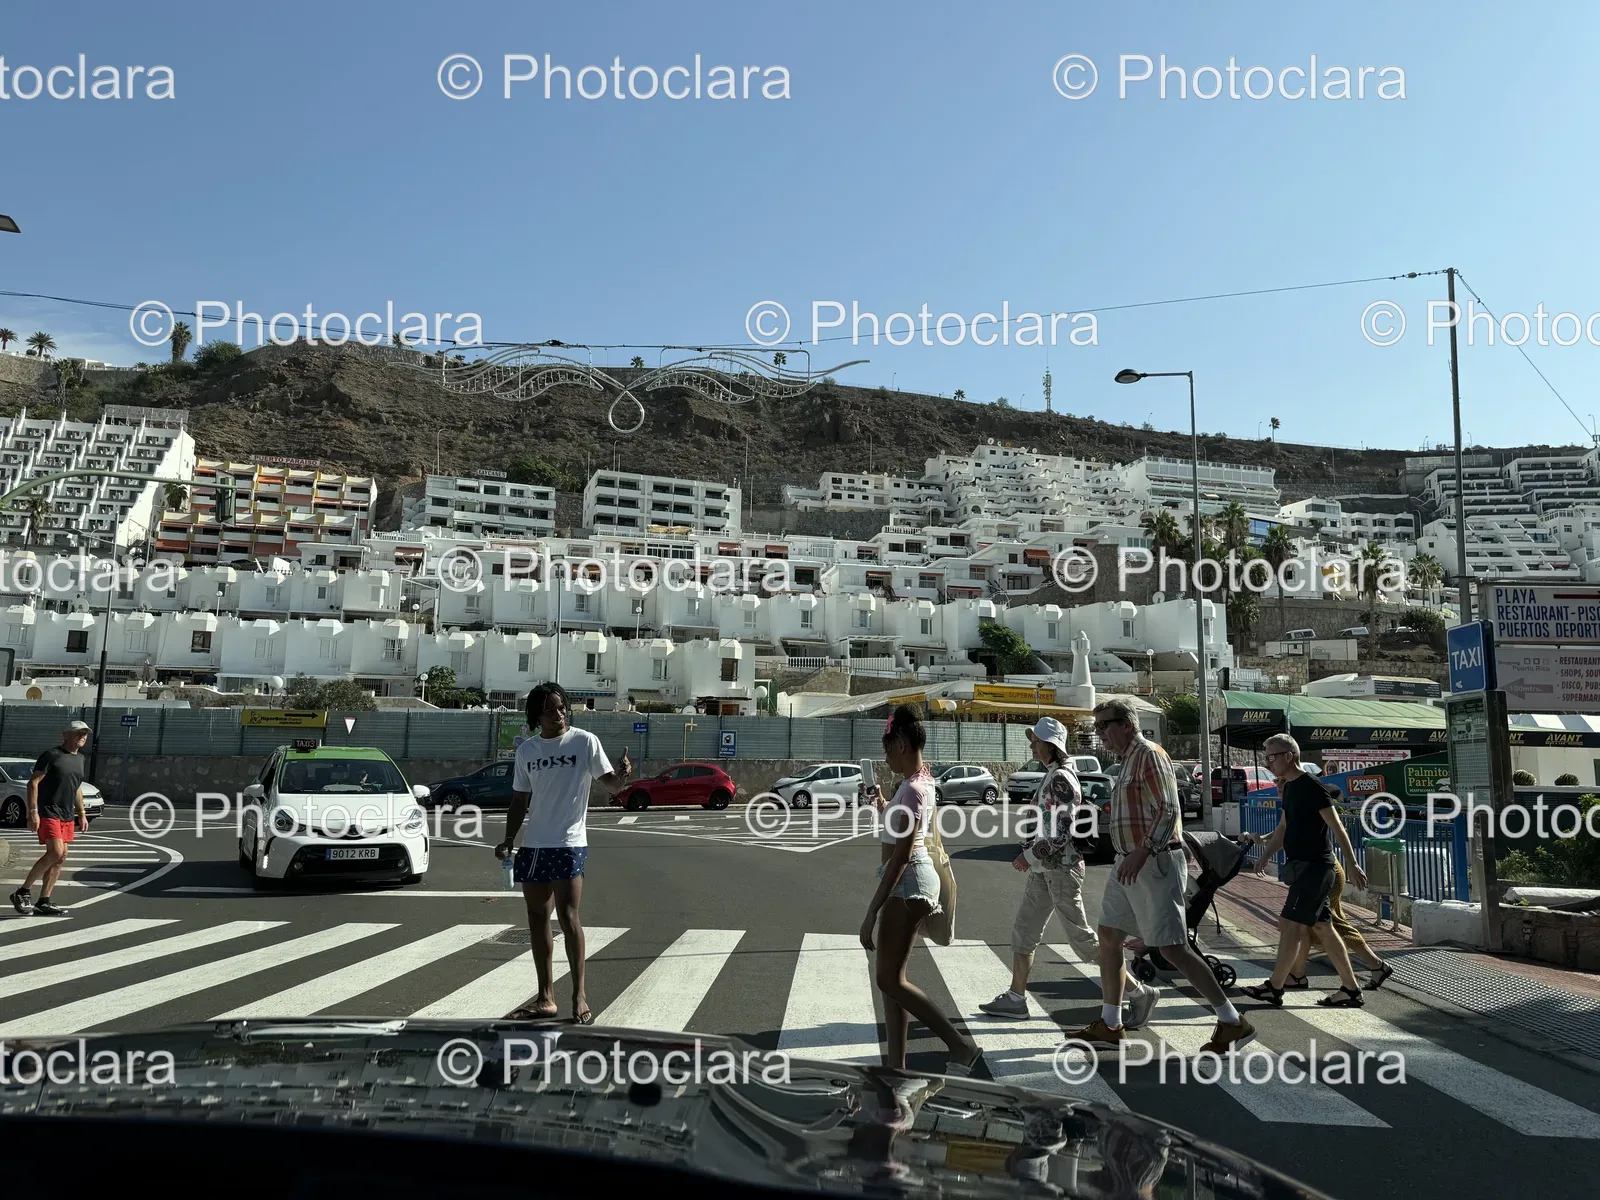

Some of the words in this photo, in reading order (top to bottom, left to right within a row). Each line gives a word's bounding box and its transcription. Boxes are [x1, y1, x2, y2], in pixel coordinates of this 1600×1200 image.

[1496, 589, 1537, 604] PLAYA
[1500, 622, 1550, 638] PUERTOS
[1556, 622, 1600, 638] DEPORT
[1452, 646, 1482, 671] TAXI
[1561, 669, 1583, 679] SHOPS,
[1562, 681, 1583, 691] DISCO,
[1243, 711, 1270, 719] AVANT
[1311, 728, 1347, 737] AVANT
[1370, 730, 1407, 738] AVANT
[1546, 733, 1582, 742] AVANT
[527, 755, 577, 773] BOSS
[1352, 779, 1360, 791] 2
[1408, 777, 1434, 787] Park
[332, 849, 356, 858] 9012
[359, 849, 376, 857] KRB
